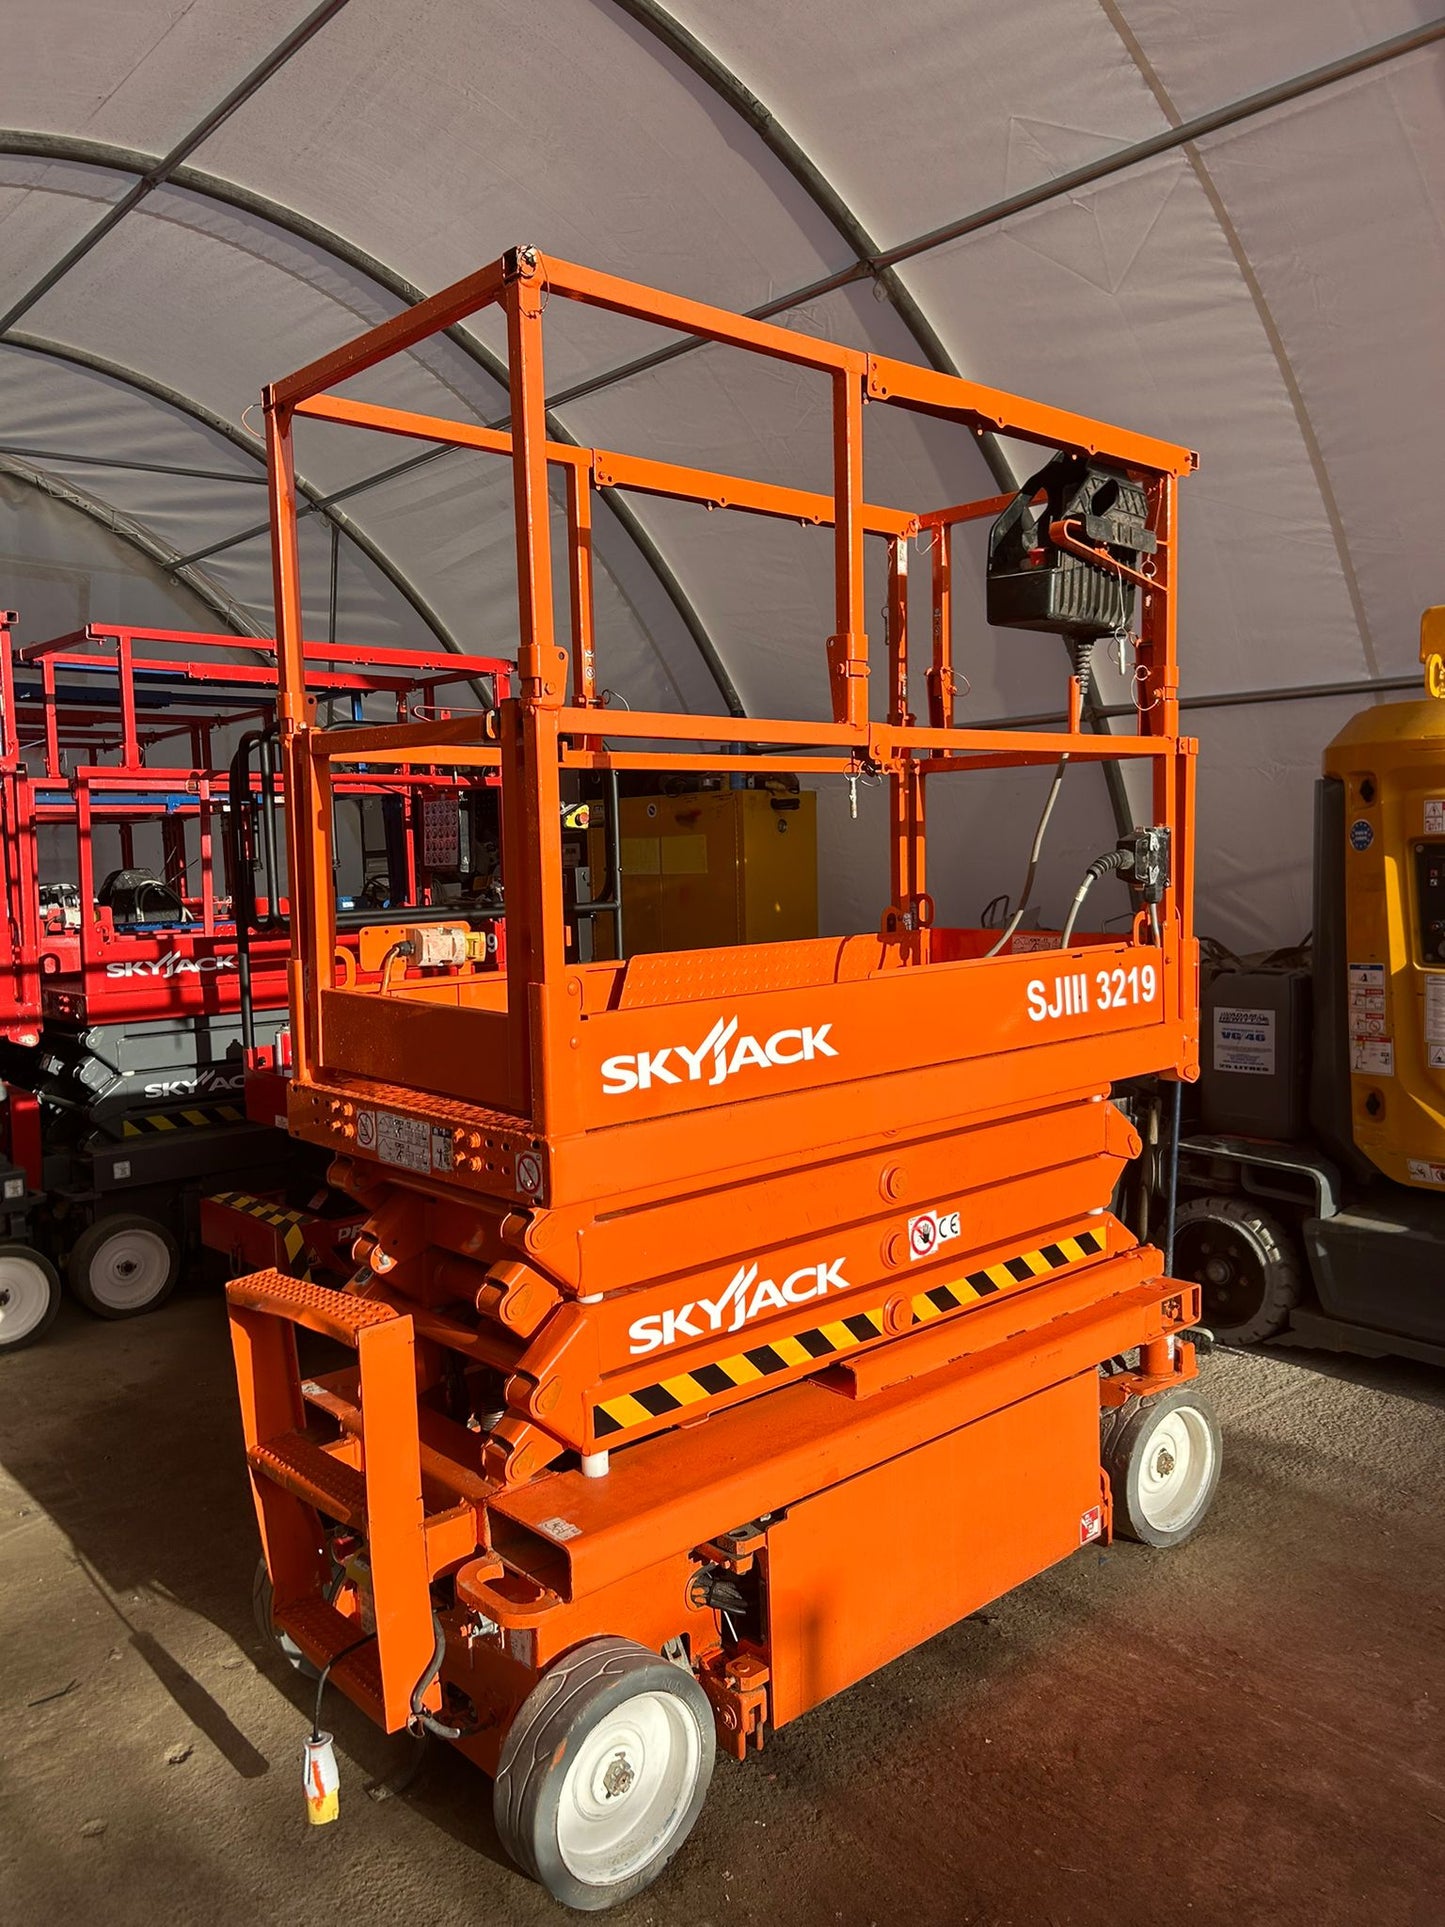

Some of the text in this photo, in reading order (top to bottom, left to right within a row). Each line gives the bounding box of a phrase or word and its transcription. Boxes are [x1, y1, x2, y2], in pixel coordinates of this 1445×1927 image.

[106, 950, 238, 979] SKYJACK
[1026, 964, 1156, 1022] SJIII 3219
[600, 1014, 840, 1094] SKYJACK
[938, 1213, 958, 1238] CE
[628, 1256, 851, 1355] SKYJACK
